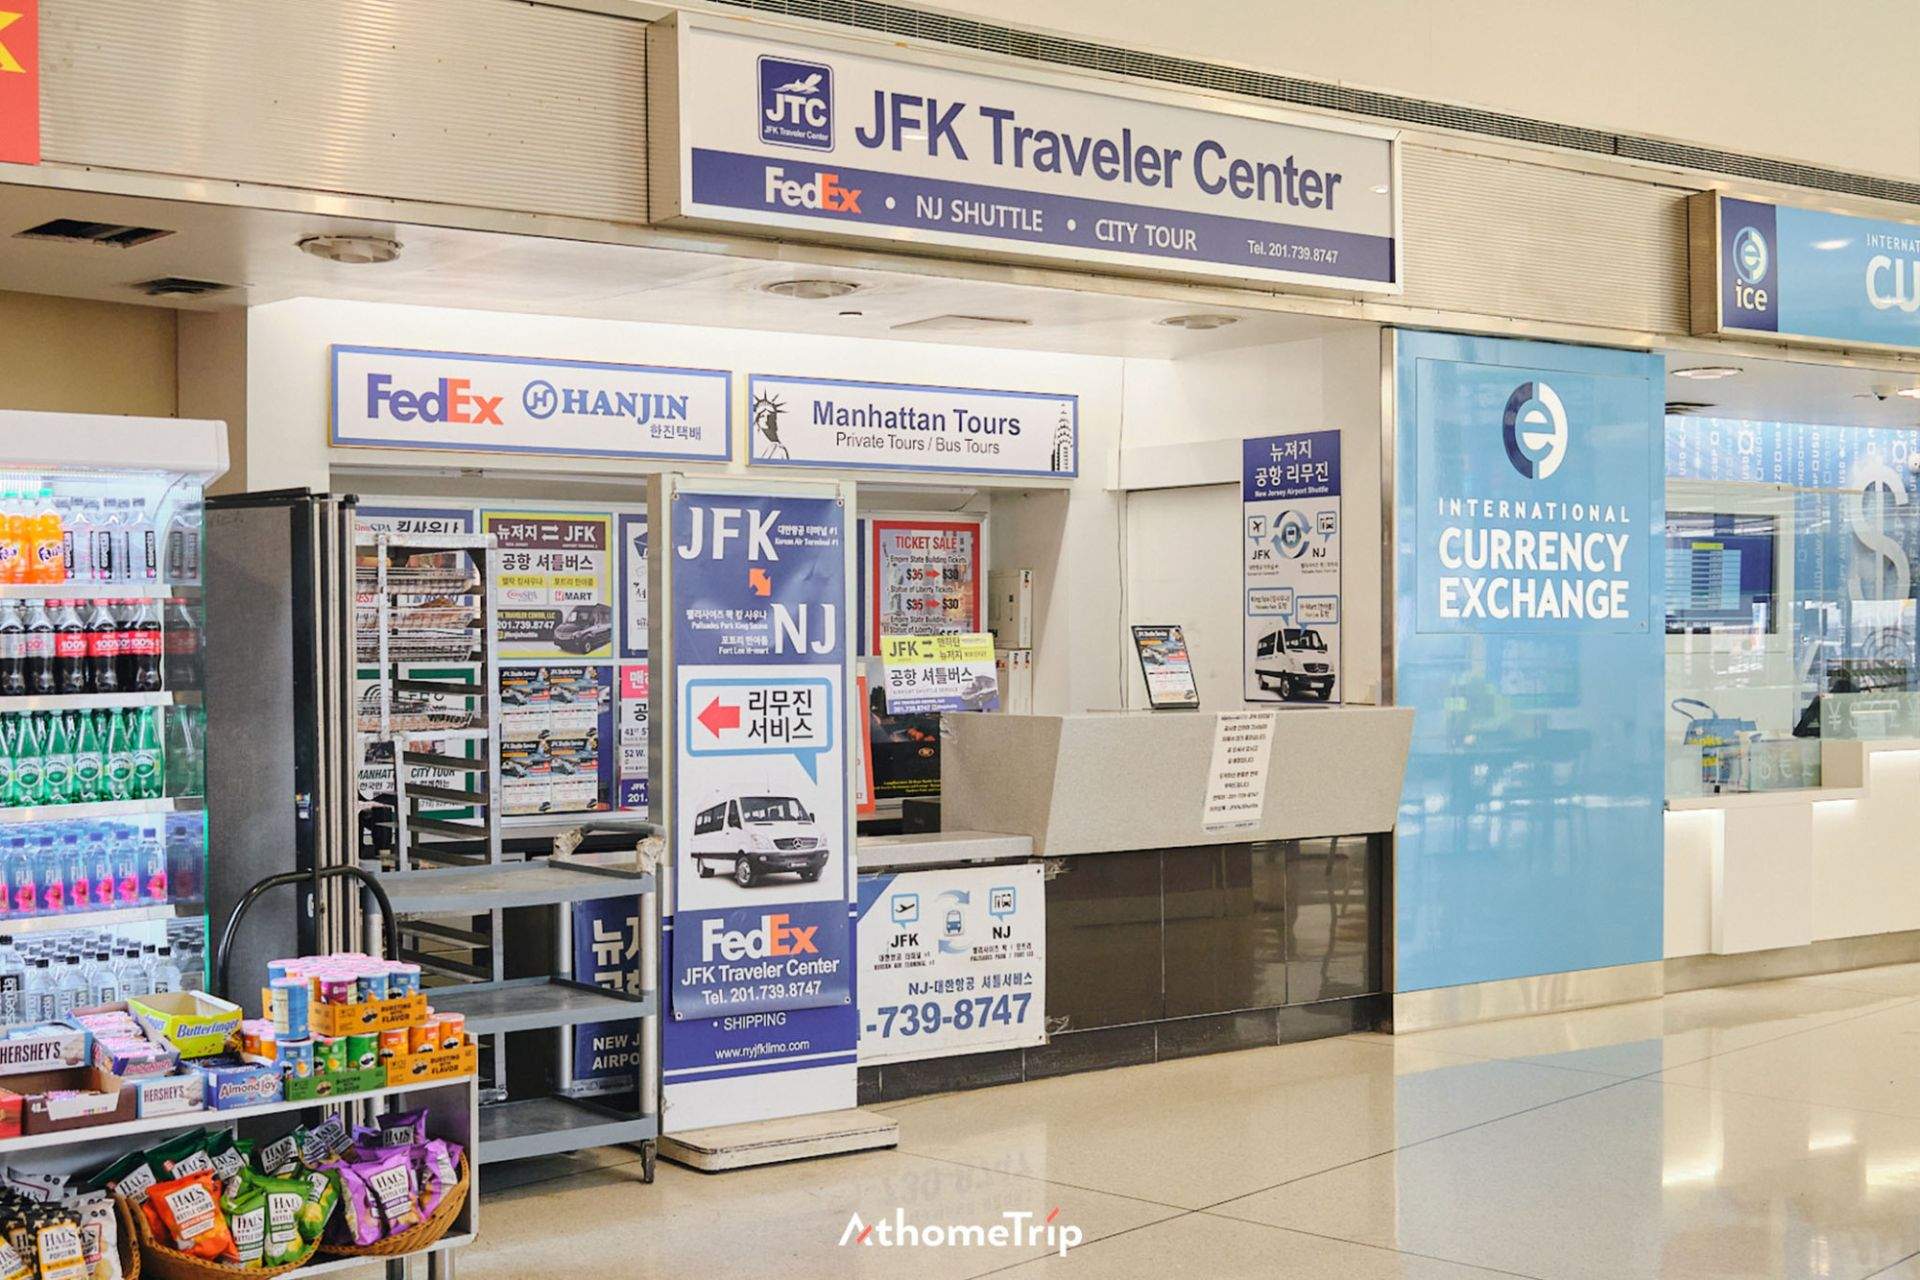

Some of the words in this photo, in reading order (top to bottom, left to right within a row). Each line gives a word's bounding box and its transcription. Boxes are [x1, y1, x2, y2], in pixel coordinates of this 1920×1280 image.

[765, 93, 827, 127] JTC
[764, 124, 778, 137] JFK
[779, 127, 807, 139] Traveler
[807, 130, 829, 141] Center
[855, 90, 968, 161] JFK
[979, 106, 1182, 189] Traveler
[1193, 140, 1342, 210] Center
[765, 166, 862, 214] FedEx
[916, 196, 942, 220] NJ
[951, 200, 1043, 232] SHUTTLE
[1095, 219, 1139, 244] CITY
[1144, 223, 1197, 251] TOUR
[1247, 239, 1266, 256] Tel.
[1269, 243, 1338, 264] 201.739.8747
[1736, 279, 1768, 311] ice
[367, 373, 504, 426] FedEx
[561, 388, 689, 425] HANJIN
[813, 400, 946, 432] Manhattan
[953, 408, 1022, 436] Tours
[649, 423, 702, 441] 한진택배
[836, 431, 885, 450] Private
[888, 434, 925, 451] Tours
[936, 437, 962, 453] Bus
[964, 439, 1000, 455] Tours
[1255, 465, 1283, 487] 공항
[1287, 461, 1329, 484] 리무진
[1287, 487, 1307, 497] Airport
[1438, 497, 1630, 523] INTERNATIONAL
[497, 524, 538, 541] 뉴저지
[564, 525, 596, 542] JFK
[678, 507, 781, 562] JFK
[896, 536, 930, 550] TICKET
[932, 536, 957, 550] SALE
[1252, 549, 1271, 560] JFK
[1312, 547, 1326, 558] NJ
[1439, 527, 1630, 573] CURRENCY
[502, 553, 531, 571] 공항
[536, 553, 594, 572] 셔틀버스
[942, 598, 959, 610] $30
[1439, 576, 1630, 619] EXCHANGE
[770, 603, 836, 655] NJ
[890, 641, 919, 658] JFK
[891, 668, 917, 687] 공항
[922, 667, 974, 685] 셔틀버스
[748, 688, 813, 717] 리무진
[748, 716, 814, 744] 서비스
[702, 913, 819, 962] FedEx
[891, 933, 919, 948] JFK
[992, 925, 1011, 939] NJ
[681, 965, 715, 986] JFK
[718, 961, 784, 984] Traveler
[786, 957, 840, 977] Center
[702, 989, 727, 1006] Tel.
[730, 981, 822, 1004] 201.739.8747
[908, 977, 975, 996] NJ-대한항공
[176, 1018, 239, 1039] Butterfinger
[724, 1012, 787, 1031] SHIPPING
[0, 1041, 61, 1066] HERSHEY'S
[593, 1034, 629, 1052] NEW
[715, 1040, 810, 1060] www.nyjfklimo.com
[143, 1084, 185, 1104] HERSHEY'S
[219, 1081, 260, 1101] Almond
